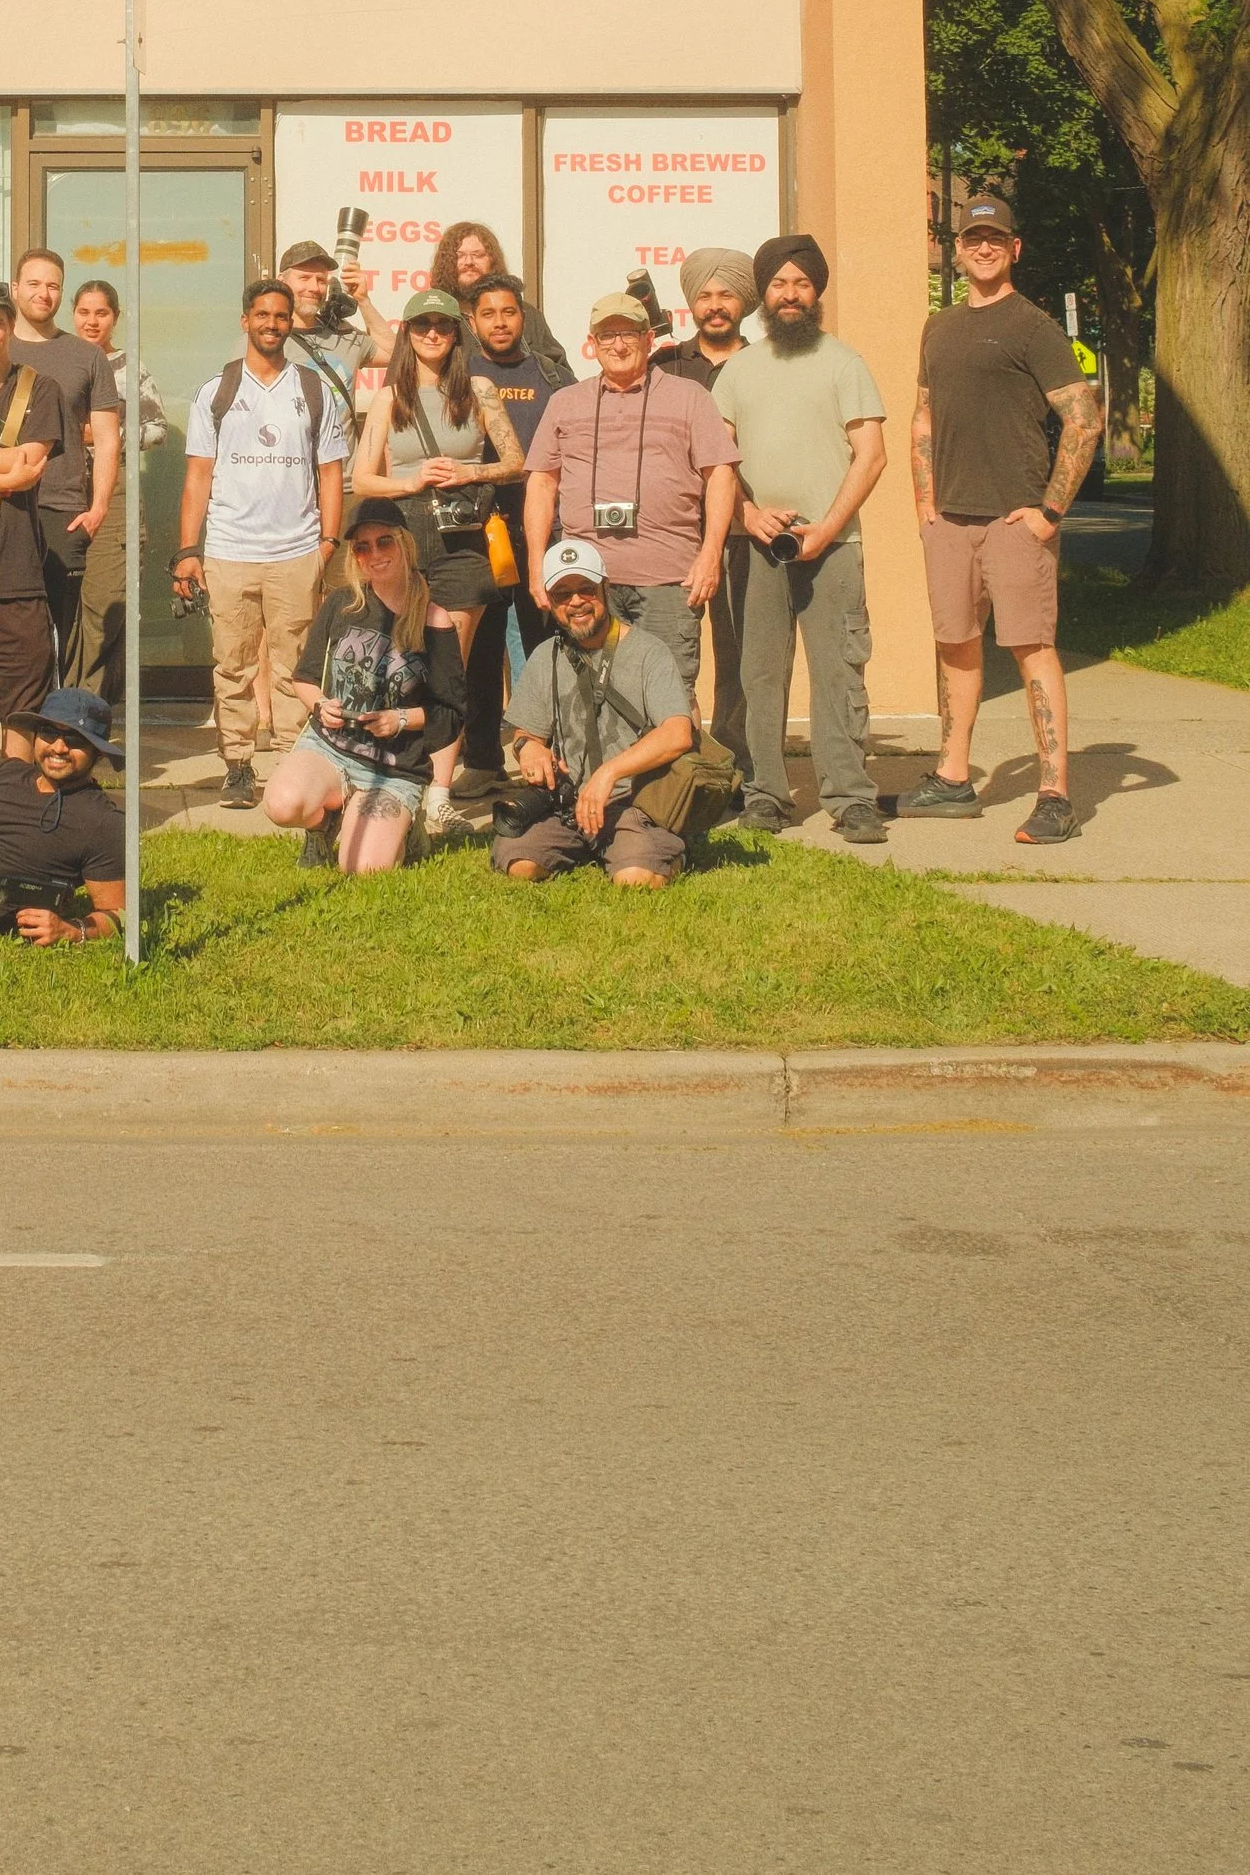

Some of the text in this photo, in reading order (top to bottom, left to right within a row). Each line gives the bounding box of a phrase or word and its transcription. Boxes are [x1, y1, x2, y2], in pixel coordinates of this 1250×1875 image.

[345, 121, 452, 143] BREAD
[554, 153, 766, 172] FRESH BREWED
[359, 171, 438, 193] MILK
[608, 185, 713, 204] COFFEE
[352, 220, 442, 243] EGGS
[635, 247, 687, 265] TEA
[498, 387, 535, 400] OSTER
[230, 453, 307, 467] Snapdragon
